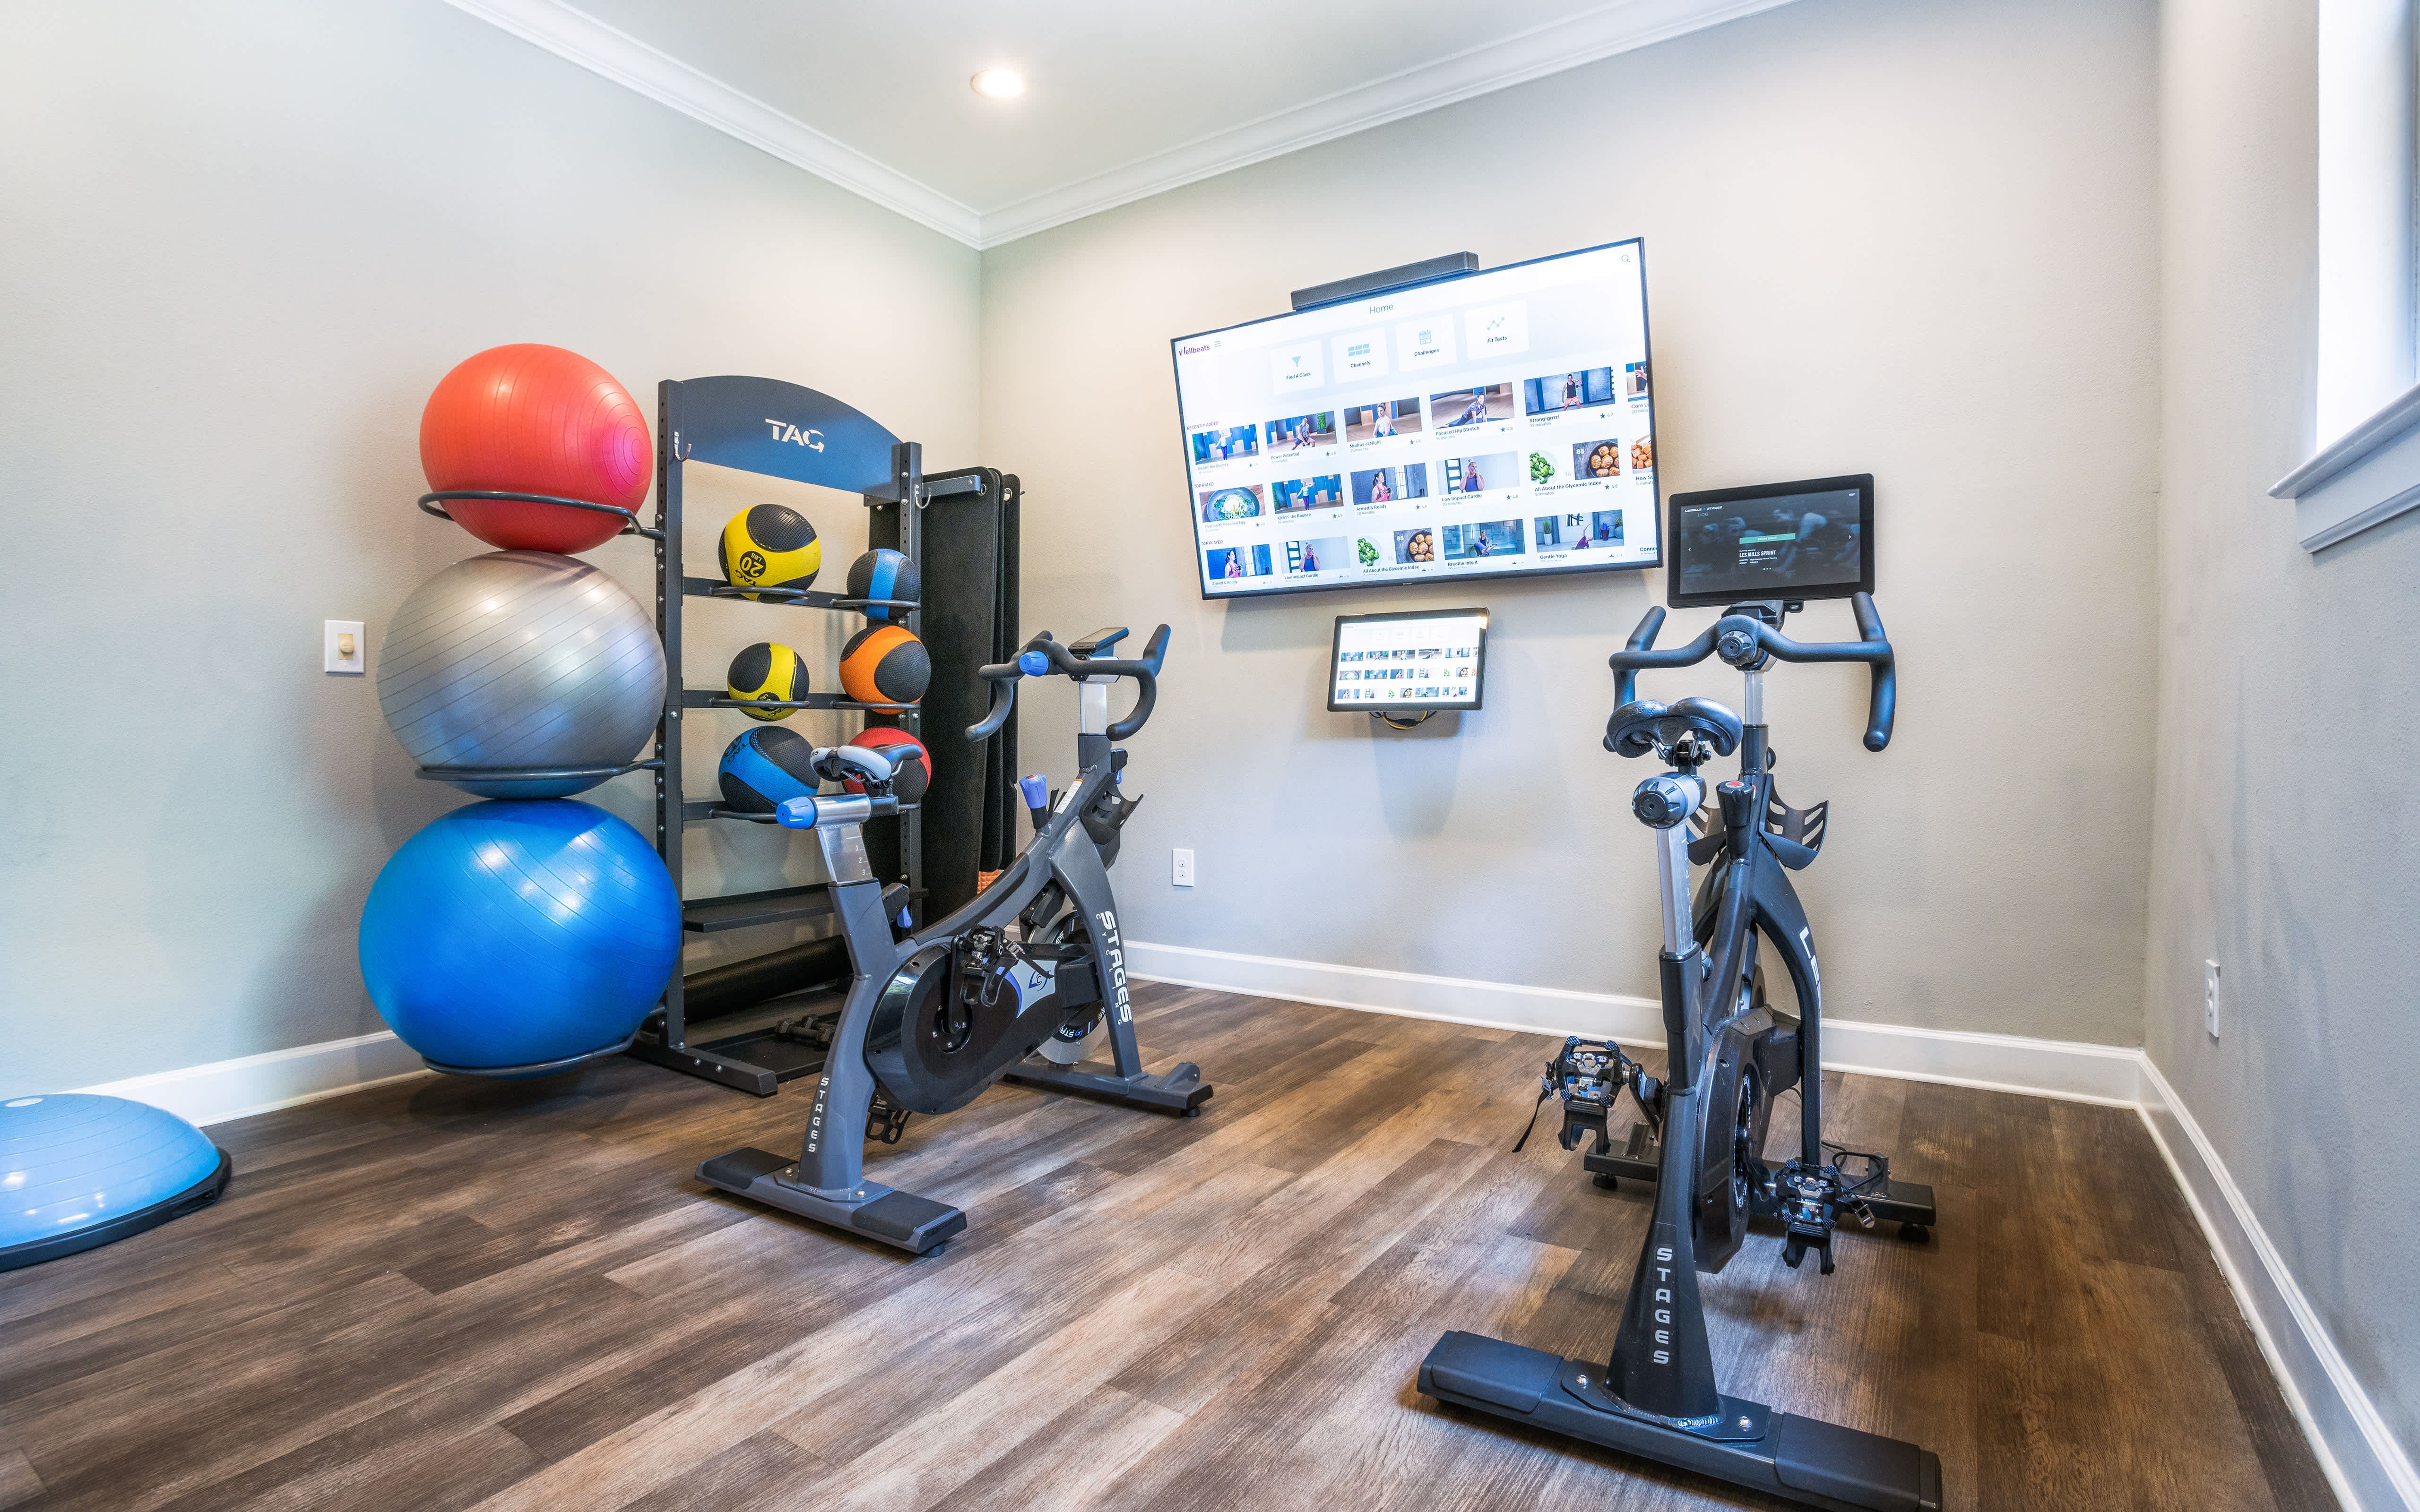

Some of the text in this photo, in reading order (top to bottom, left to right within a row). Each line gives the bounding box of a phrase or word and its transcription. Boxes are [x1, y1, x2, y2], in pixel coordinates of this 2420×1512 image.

[1369, 303, 1394, 314] Home
[1178, 344, 1210, 356] Wellbeats
[1414, 348, 1439, 356] Challenges
[765, 418, 825, 453] TAG
[741, 556, 764, 577] 20
[751, 553, 762, 562] LBS
[1096, 913, 1122, 1025] CYCLING
[1100, 911, 1132, 1023] STAGES
[808, 1077, 829, 1153] STAGES
[1653, 1247, 1673, 1365] STAGES
